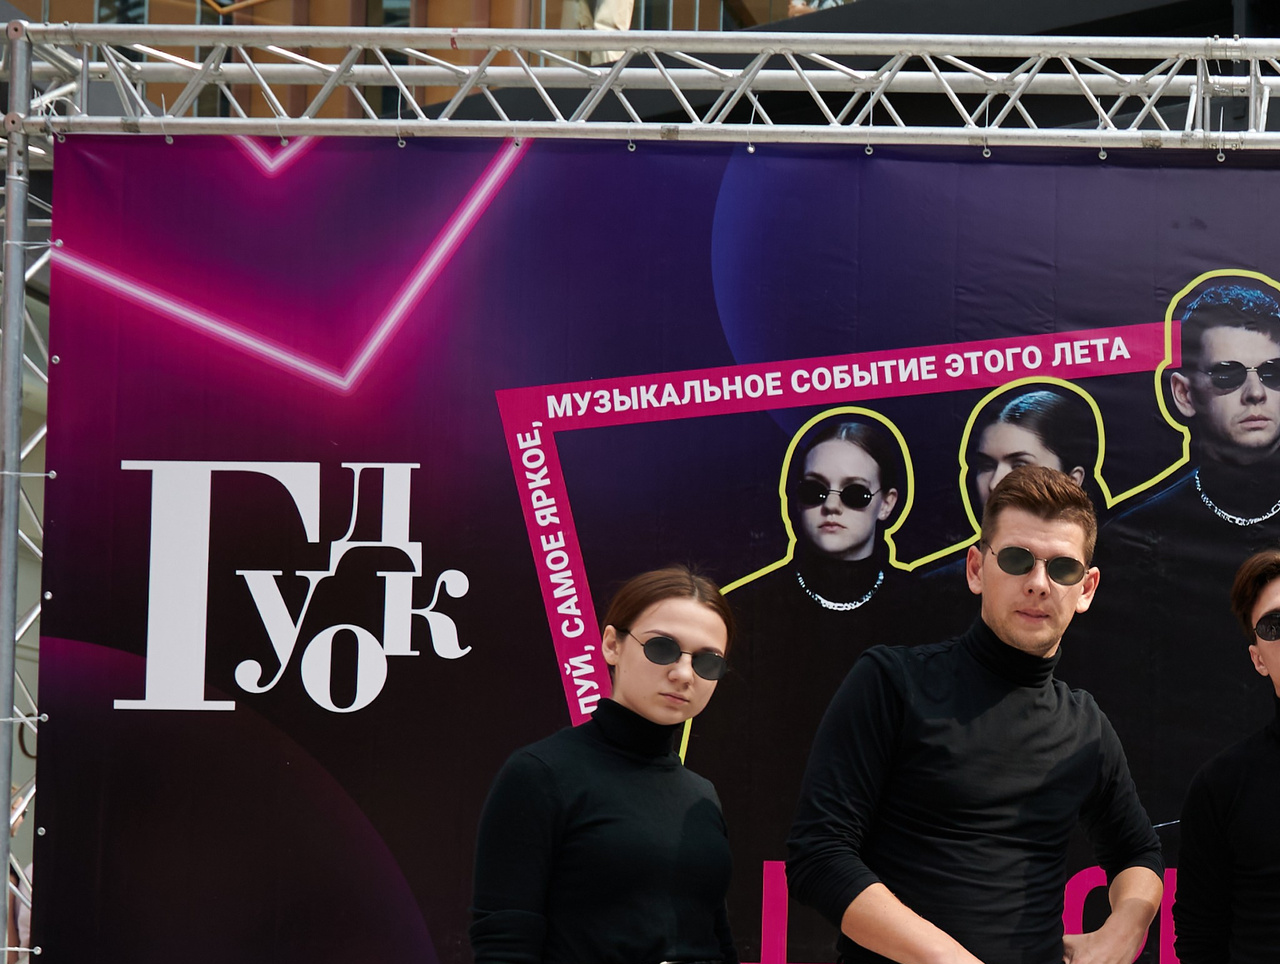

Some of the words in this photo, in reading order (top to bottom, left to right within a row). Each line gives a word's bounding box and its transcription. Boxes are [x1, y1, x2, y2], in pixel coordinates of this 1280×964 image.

[547, 371, 783, 419] МУЗЫКАЛЬНОЕ
[791, 355, 938, 393] СОБЫТИЕ
[944, 345, 1042, 378] ЭТОГО
[1051, 336, 1131, 367] ЛЕТА
[517, 421, 560, 527] ЯРКОЕ,
[540, 531, 585, 638] САМОЕ
